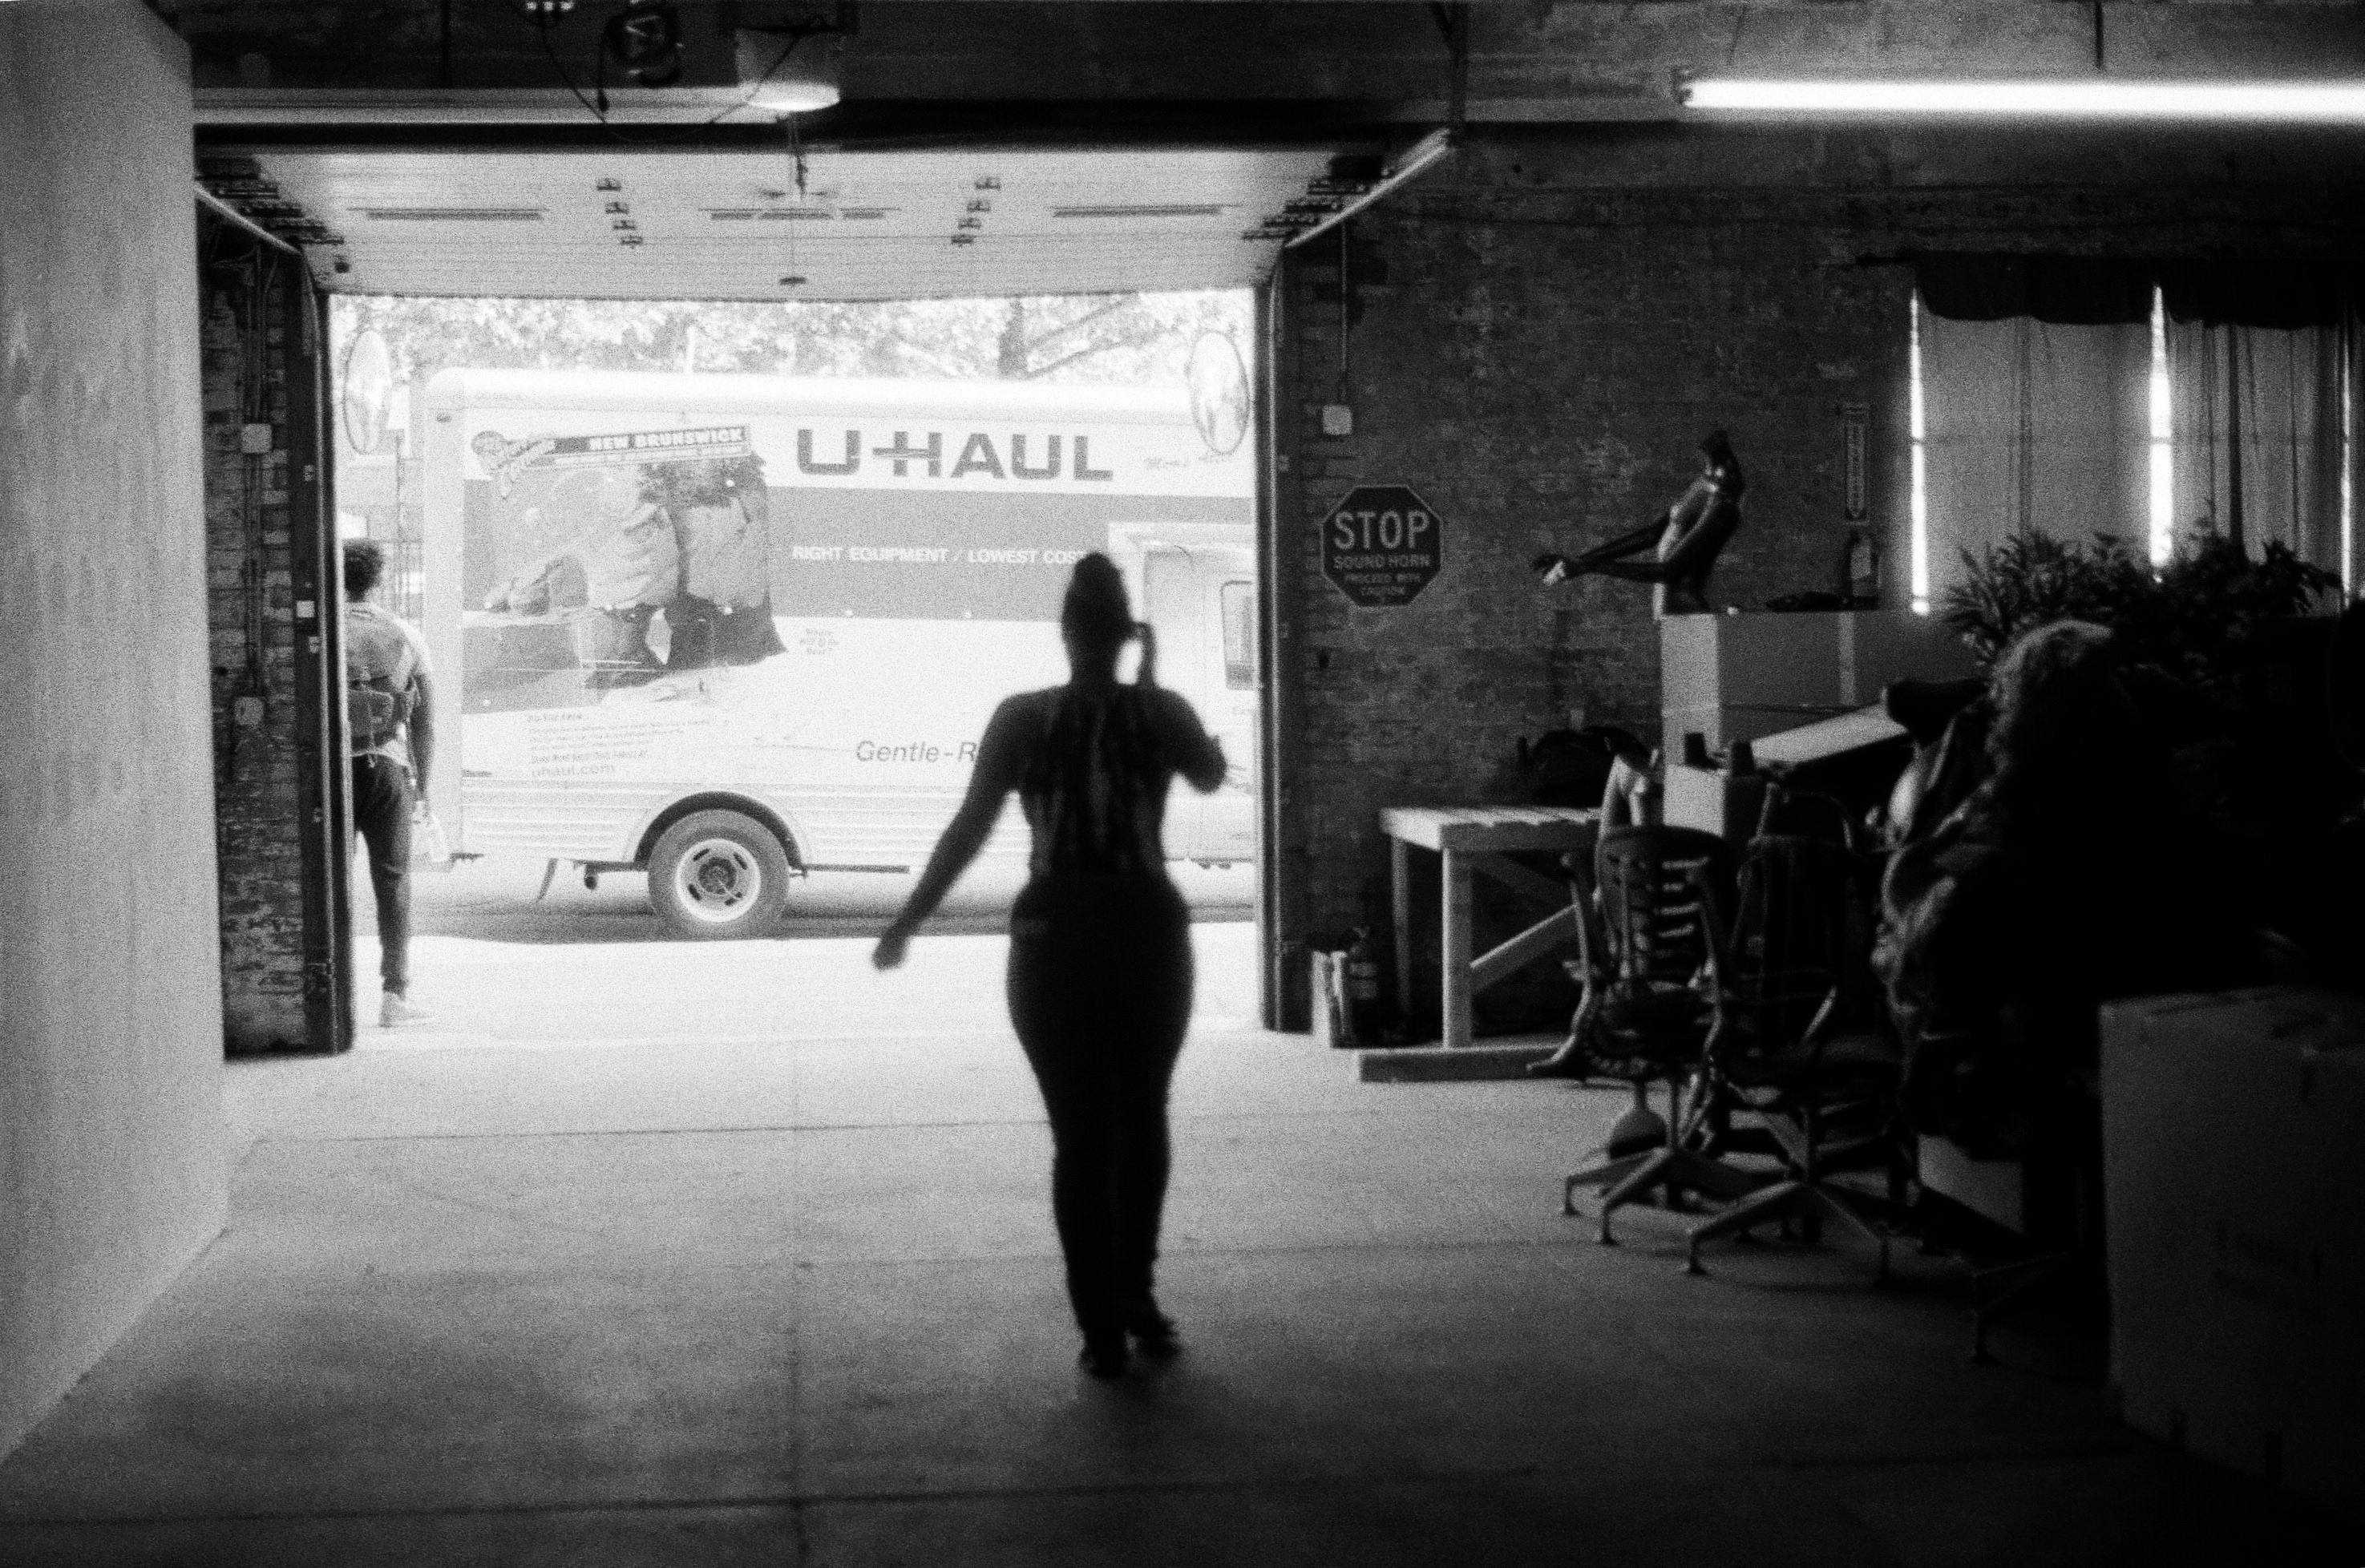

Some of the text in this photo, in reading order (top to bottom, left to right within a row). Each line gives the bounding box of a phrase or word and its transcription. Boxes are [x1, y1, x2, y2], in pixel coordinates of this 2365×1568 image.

[589, 429, 742, 451] NEW BRUNSWICK
[796, 428, 1114, 481] U-HAUL
[1334, 509, 1429, 549] STOP
[792, 546, 843, 560] RIGHT
[849, 547, 948, 562] EQUIPMENT
[968, 549, 1037, 563] LOWEST
[1333, 553, 1431, 569] SOUND HORN
[855, 739, 977, 762] Gentle-R
